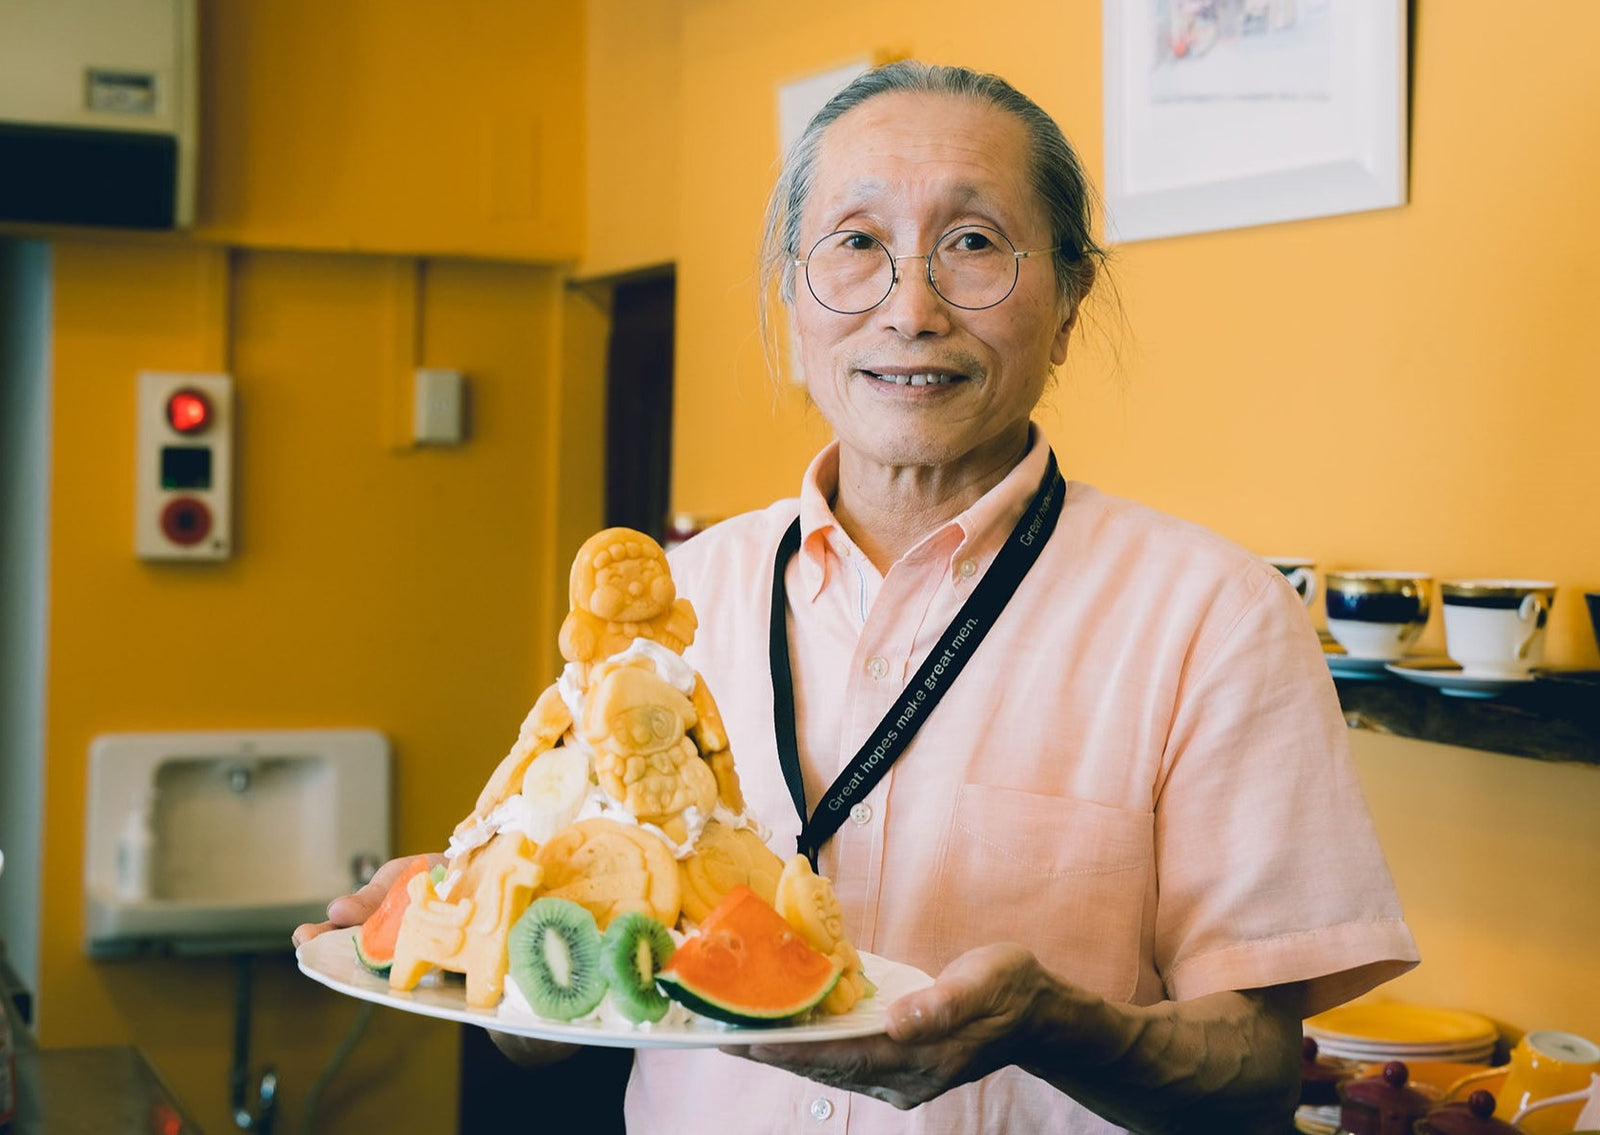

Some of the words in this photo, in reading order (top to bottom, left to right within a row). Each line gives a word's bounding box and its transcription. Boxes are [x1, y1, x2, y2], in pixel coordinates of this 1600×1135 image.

[1020, 515, 1042, 546] Great
[828, 771, 865, 811] Great
[859, 729, 898, 774] hopes
[896, 689, 926, 730] make
[924, 649, 955, 691] great
[951, 617, 979, 651] men.
